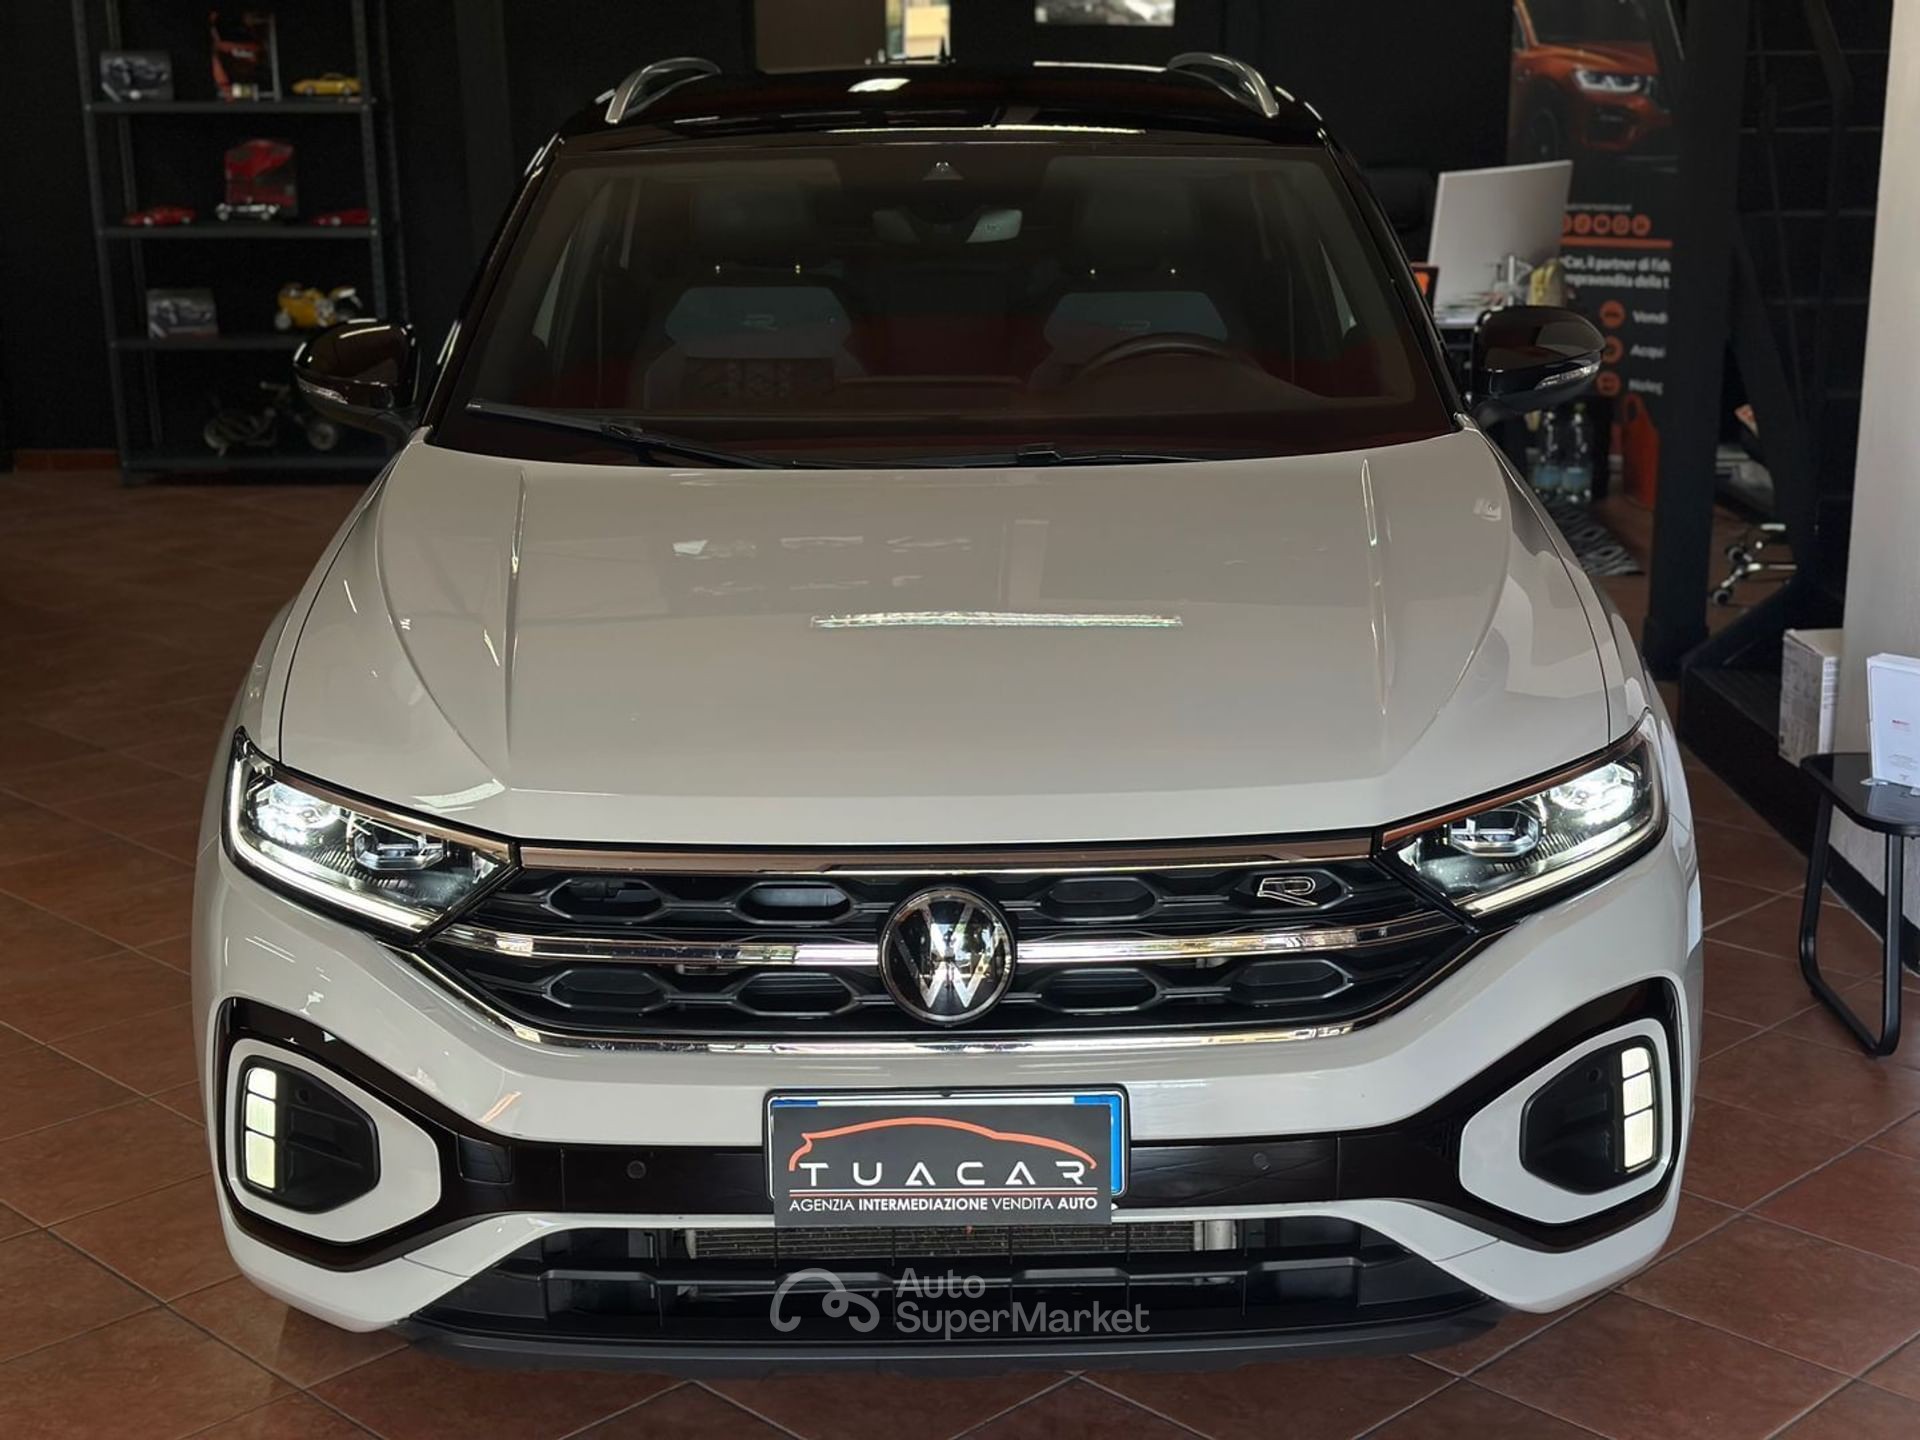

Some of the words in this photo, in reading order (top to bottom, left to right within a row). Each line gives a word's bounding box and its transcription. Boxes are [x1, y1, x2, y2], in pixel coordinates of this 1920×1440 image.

[1595, 258, 1636, 272] partner
[1257, 876, 1318, 906] R
[799, 1161, 1085, 1186] TUACAR
[789, 1198, 855, 1211] AGENZIA
[859, 1198, 988, 1211] INTERMEDIAZIONE
[991, 1197, 1054, 1210] VENDITA
[1057, 1197, 1098, 1210] AUTO
